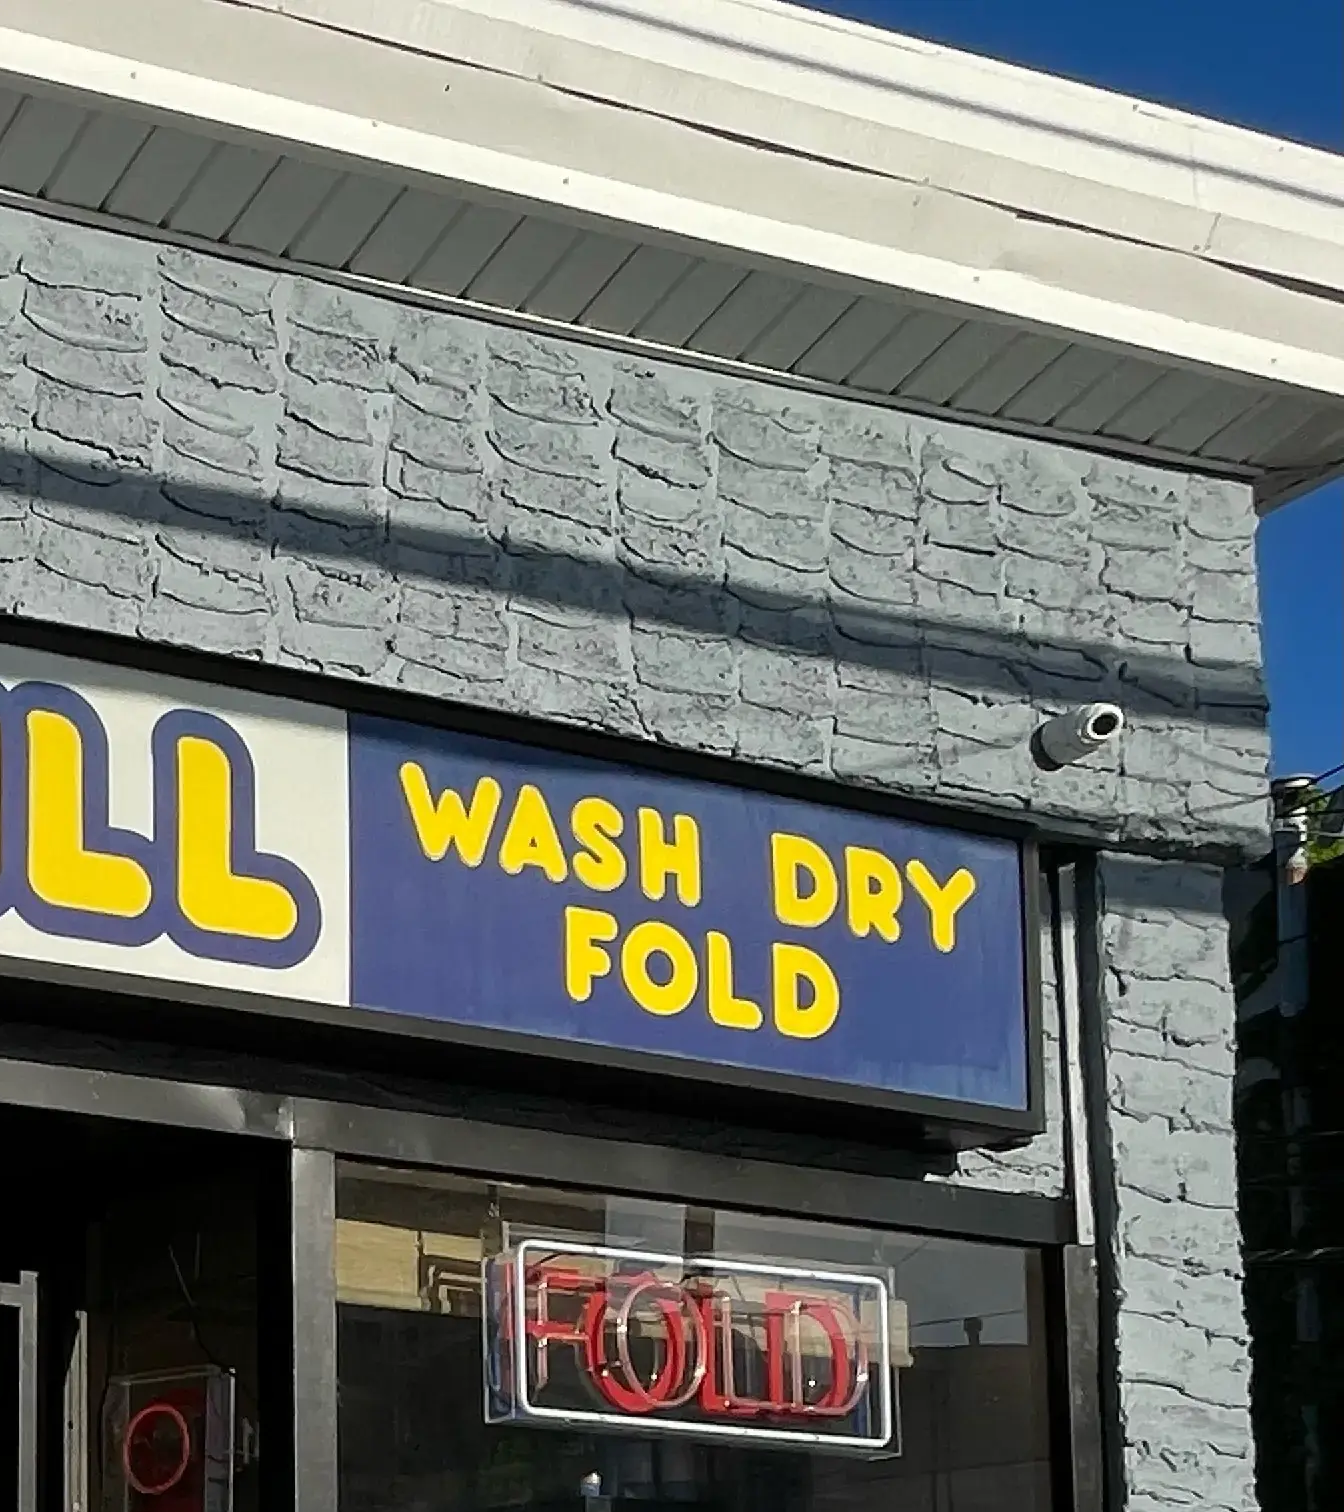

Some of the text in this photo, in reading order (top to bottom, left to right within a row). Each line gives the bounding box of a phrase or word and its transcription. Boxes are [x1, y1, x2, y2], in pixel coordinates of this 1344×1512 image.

[397, 759, 977, 955] WASH DRY
[564, 908, 841, 1039] FOLD
[502, 1260, 870, 1418] FOLD
